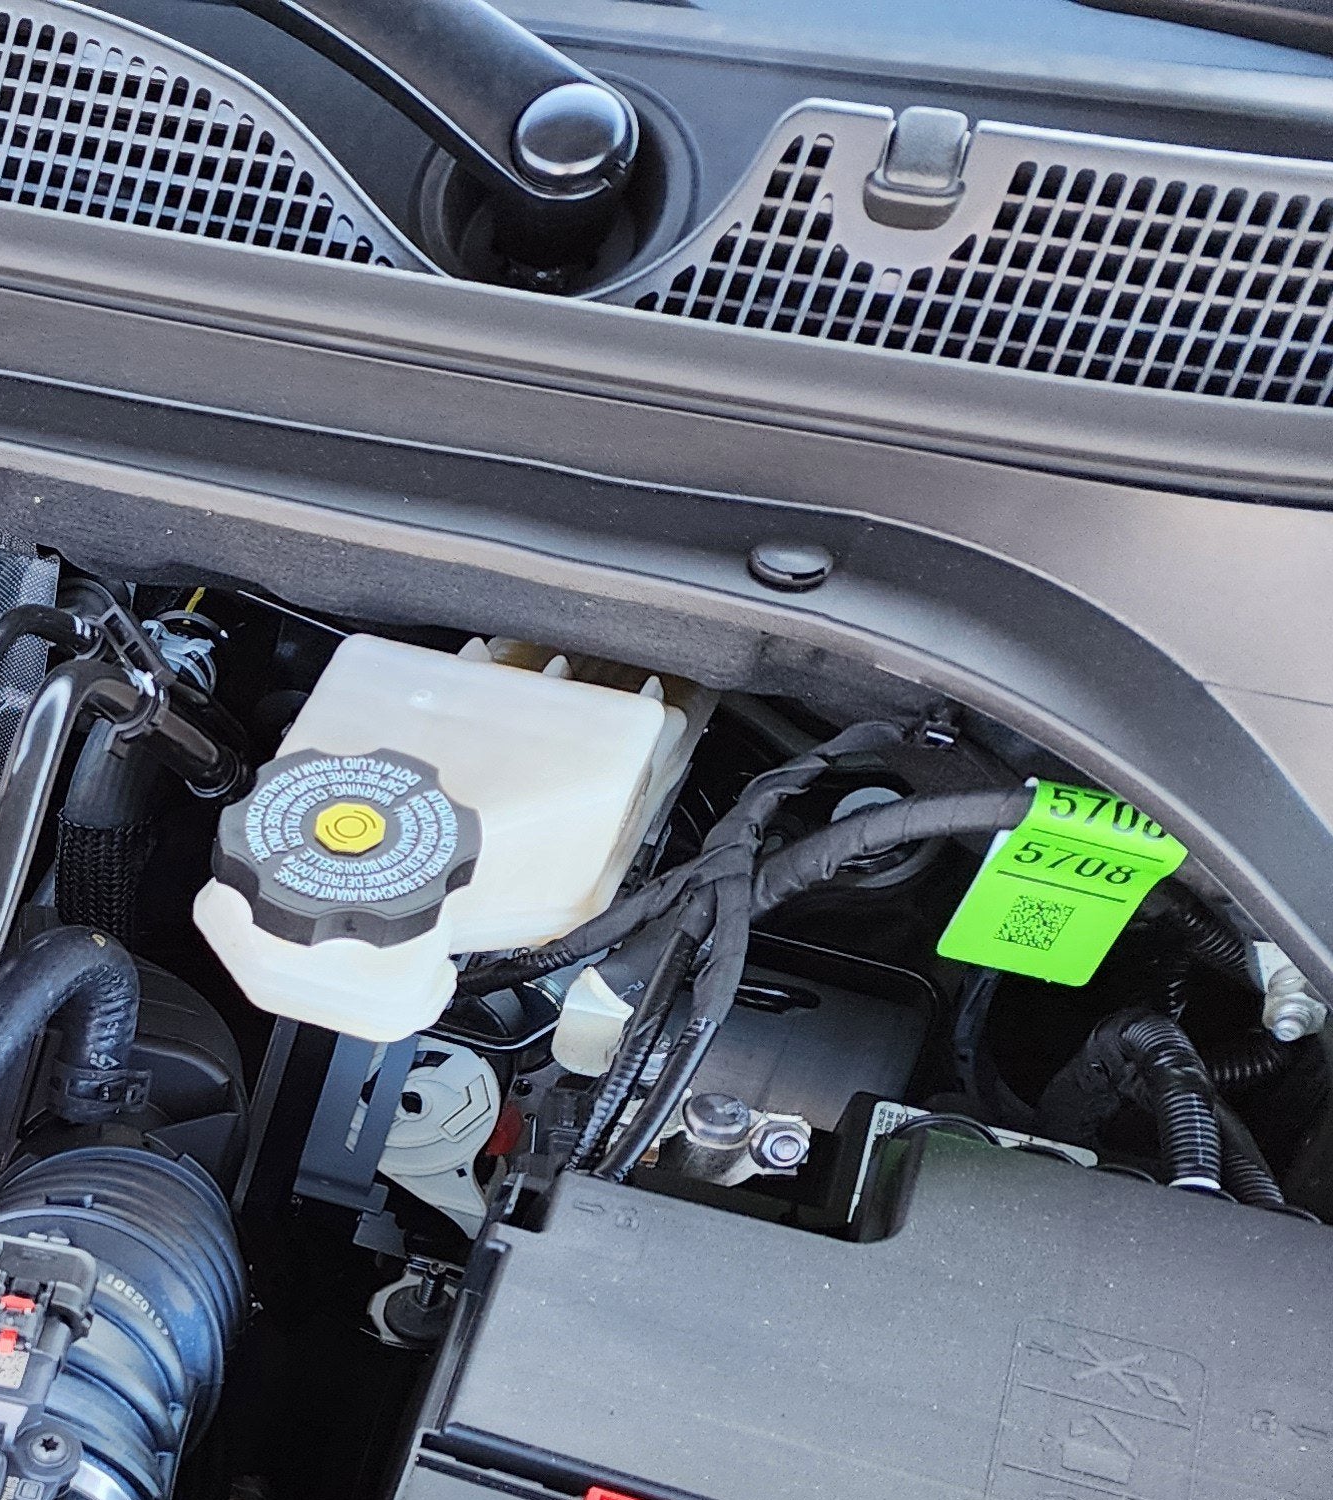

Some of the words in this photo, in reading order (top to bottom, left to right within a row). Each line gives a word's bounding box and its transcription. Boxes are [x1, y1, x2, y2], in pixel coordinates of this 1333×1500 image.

[298, 757, 341, 778] FROM
[341, 757, 385, 773] FLUID
[325, 770, 382, 785] BEFORE
[377, 774, 412, 796] CAP
[252, 771, 298, 807] SEALED
[289, 788, 330, 816] CLEAN
[264, 827, 289, 855] ONLY
[284, 813, 307, 847] FILLER
[343, 859, 382, 874] BIDON
[1014, 841, 1137, 885] 5708
[315, 885, 359, 901] AVANT
